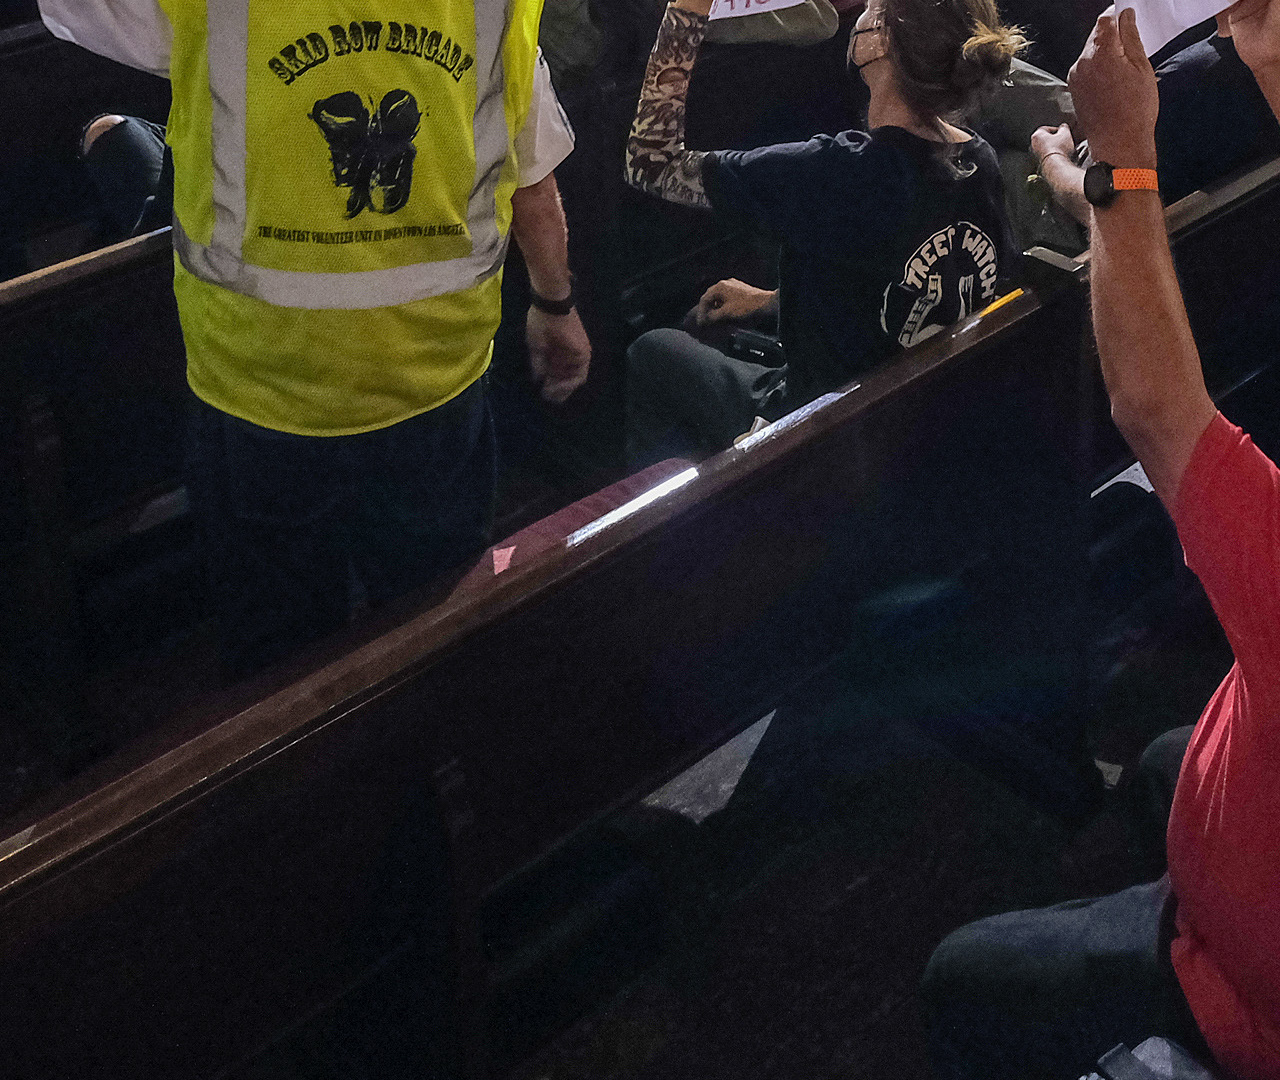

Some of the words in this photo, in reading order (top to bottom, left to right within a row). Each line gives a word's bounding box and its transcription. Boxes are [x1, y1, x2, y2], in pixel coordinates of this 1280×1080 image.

[268, 32, 330, 85] SKID
[328, 21, 383, 57] ROW
[385, 21, 474, 83] BRIGADE
[962, 229, 997, 299] WATCH
